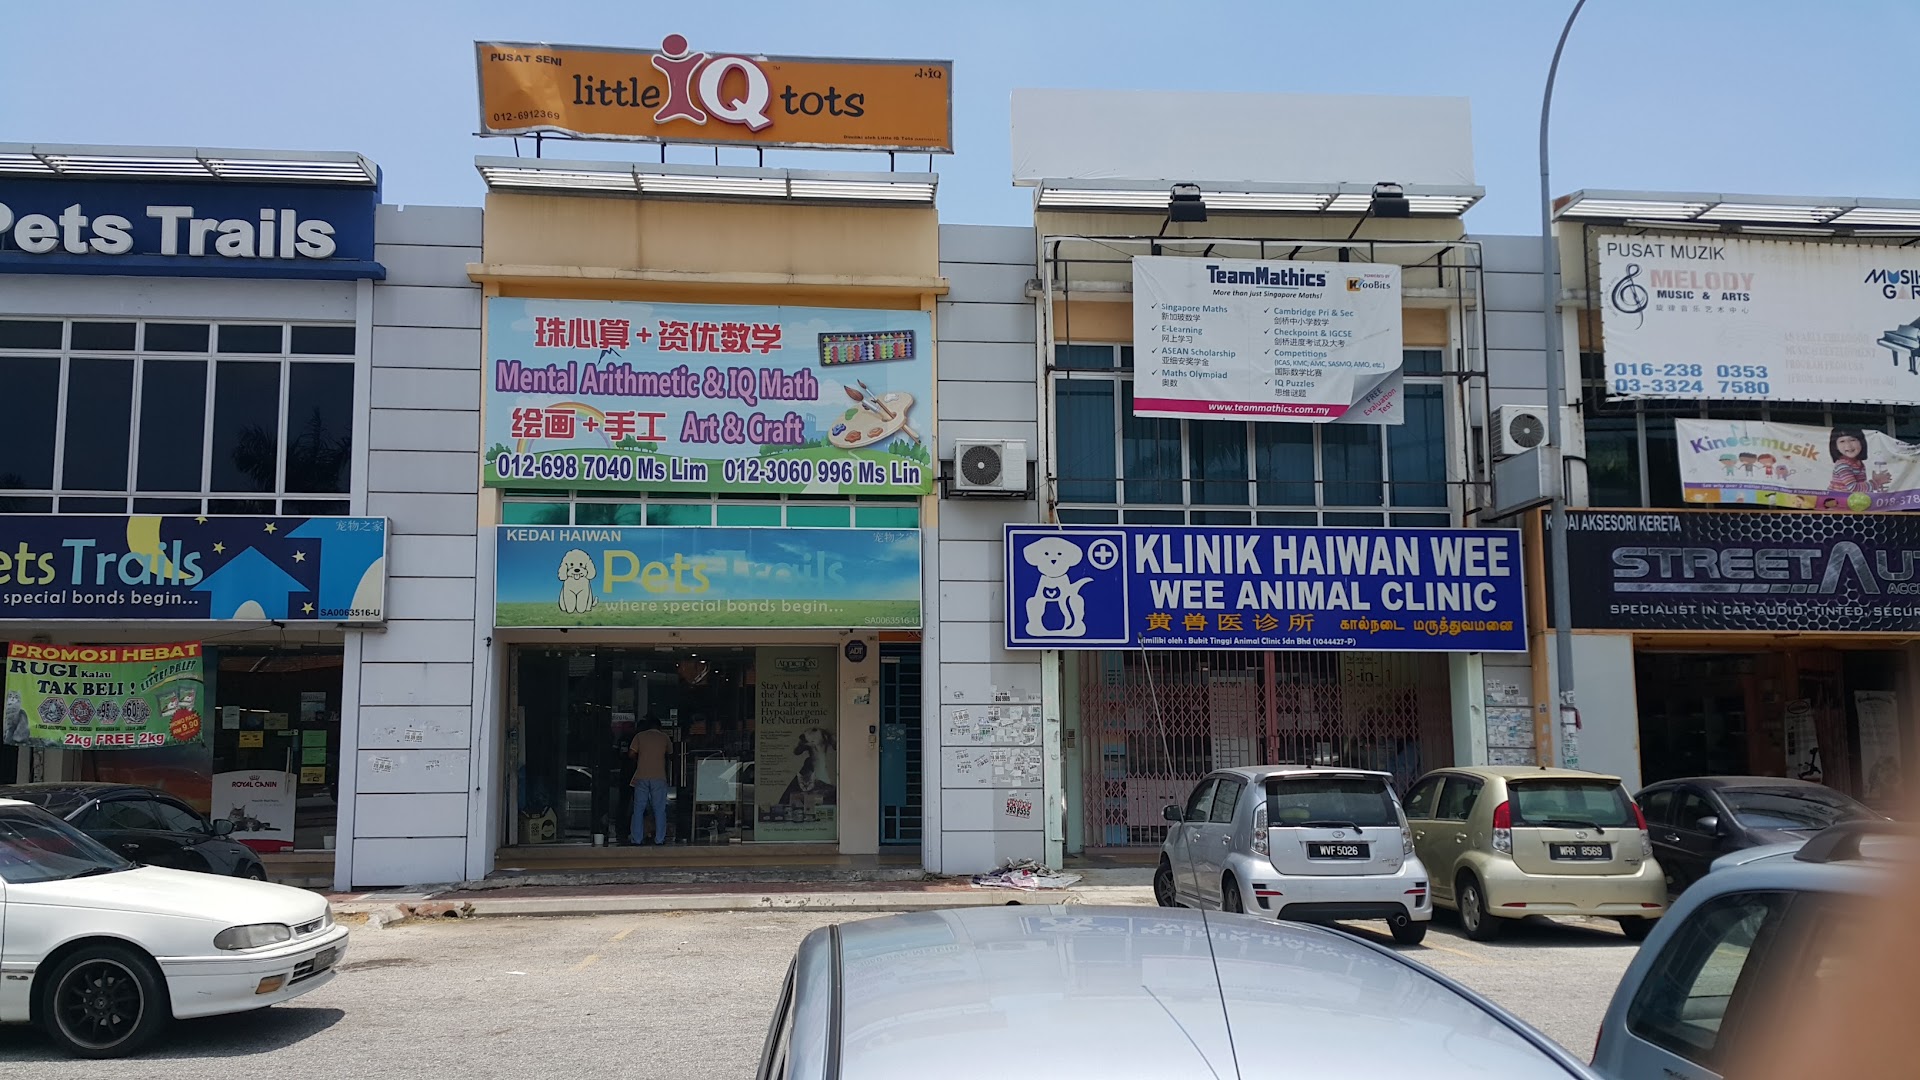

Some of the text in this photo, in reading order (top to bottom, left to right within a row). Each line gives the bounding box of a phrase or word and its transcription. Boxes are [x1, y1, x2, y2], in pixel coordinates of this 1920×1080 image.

[490, 53, 562, 66] PUSAT SENI
[572, 73, 660, 109] little
[779, 84, 865, 118] tots
[493, 109, 560, 122] 012-6912369
[146, 205, 337, 259] Trails
[1606, 242, 1725, 261] PUSAT MUZIK
[1205, 265, 1326, 287] TeamMathics
[1650, 268, 1755, 291] MELODY
[1249, 290, 1262, 298] just
[1263, 291, 1297, 299] Singapore
[1298, 292, 1323, 300] Maths!
[1656, 289, 1751, 302] MUSIC & ARTS
[1161, 303, 1228, 313] Singapore Maths
[1273, 307, 1316, 317] Cambridge
[1318, 308, 1330, 316] Pri
[1340, 309, 1354, 317] Sec
[1161, 325, 1203, 335] E-Learning
[1273, 328, 1352, 338] Checkpoint & IGCSE
[1161, 334, 1193, 343] 网上学习
[1161, 347, 1236, 358] ASEAN Scholarship
[1274, 349, 1328, 358] Competitions
[1161, 369, 1228, 379] Maths Olympiad
[1614, 361, 1769, 379] 016-238 0353
[494, 358, 819, 406] Mental Arithmetic & IQ Math
[1274, 379, 1315, 388] IQ Puzzles
[1614, 378, 1705, 394] 03-3324
[1719, 379, 1771, 396] 7580
[1363, 388, 1397, 416] Evaluation
[1365, 387, 1383, 403] FREE
[1208, 402, 1330, 416] www.teammathics.com.my
[1377, 401, 1394, 414] Test
[678, 409, 806, 446] Art & Craft
[1690, 424, 1821, 461] Kindermusik
[497, 452, 921, 486] 012-698 7040 Ms Lim 012-3060 996 Ms Lin
[335, 519, 384, 533] 宠物之家
[1581, 514, 1682, 532] AKSESORI KERETA
[506, 529, 622, 543] KEDAI HAIWAN
[61, 538, 204, 586] Trails
[1135, 534, 1511, 577] KLINIK HAIWAN WEE
[1611, 546, 1822, 580] STREET
[602, 549, 846, 594] Pets Trails
[4, 589, 200, 608] special bonds begin...
[1149, 580, 1498, 613] WEE ANIMAL CLINIC
[320, 607, 381, 618] SA0063516-U
[604, 598, 844, 616] where special bonds begin...
[1610, 603, 1697, 616] SPECIALIST
[1701, 605, 1717, 616] IN
[1722, 605, 1751, 616] CAR
[864, 616, 918, 625] SA0063516-U
[1145, 612, 1316, 632] 黄兽医诊所
[1167, 636, 1357, 647] oleh Bukit Tinggi Animal Clinic Sdn Bhd (1044427-P)
[10, 643, 199, 662] PROMOSI HEBAT
[849, 647, 863, 655] ADT
[9, 659, 112, 678] RUGI Kalau
[37, 679, 78, 695] TAK
[82, 682, 124, 696] BELI
[761, 680, 821, 691] Stay Ahead of
[761, 689, 821, 699] the Pack with
[761, 698, 819, 707] the Leader in
[761, 707, 828, 719] Hypoallergenic
[761, 716, 820, 725] Pet Nutrition
[64, 733, 93, 748] 2kg
[95, 733, 135, 745] FREE
[138, 732, 165, 746] 2kg
[1319, 845, 1359, 856] WVF 5026
[1559, 846, 1603, 856] WRR 8569
